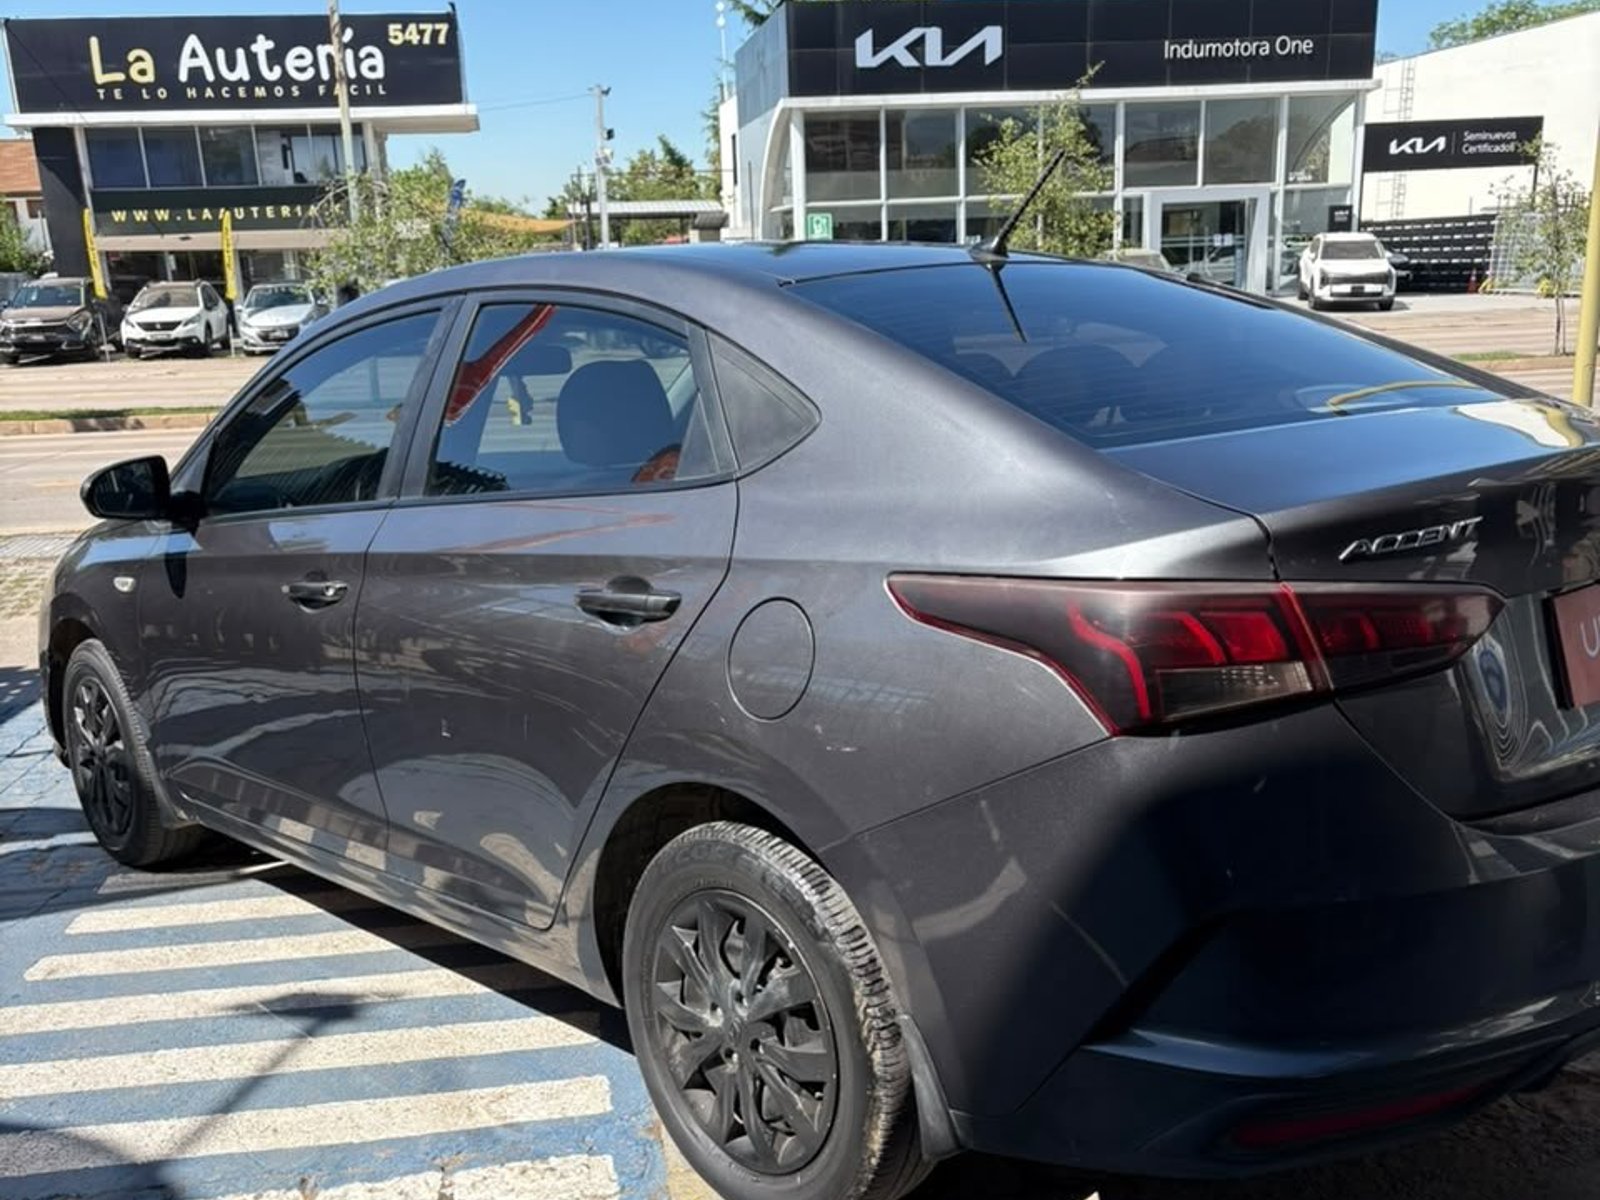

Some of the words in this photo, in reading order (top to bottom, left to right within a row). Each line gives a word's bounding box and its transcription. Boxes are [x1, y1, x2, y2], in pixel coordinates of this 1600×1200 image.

[388, 23, 449, 45] 5477
[89, 35, 155, 85] La
[178, 27, 385, 83] Autería
[855, 25, 1002, 68] KIA
[1164, 38, 1270, 59] Indumotora
[1275, 35, 1314, 55] One
[97, 88, 123, 100] TE
[142, 87, 168, 99] LO
[186, 85, 301, 99] HACEMOS
[1463, 130, 1517, 141] Seminuevos
[1338, 515, 1483, 561] ACCENT
